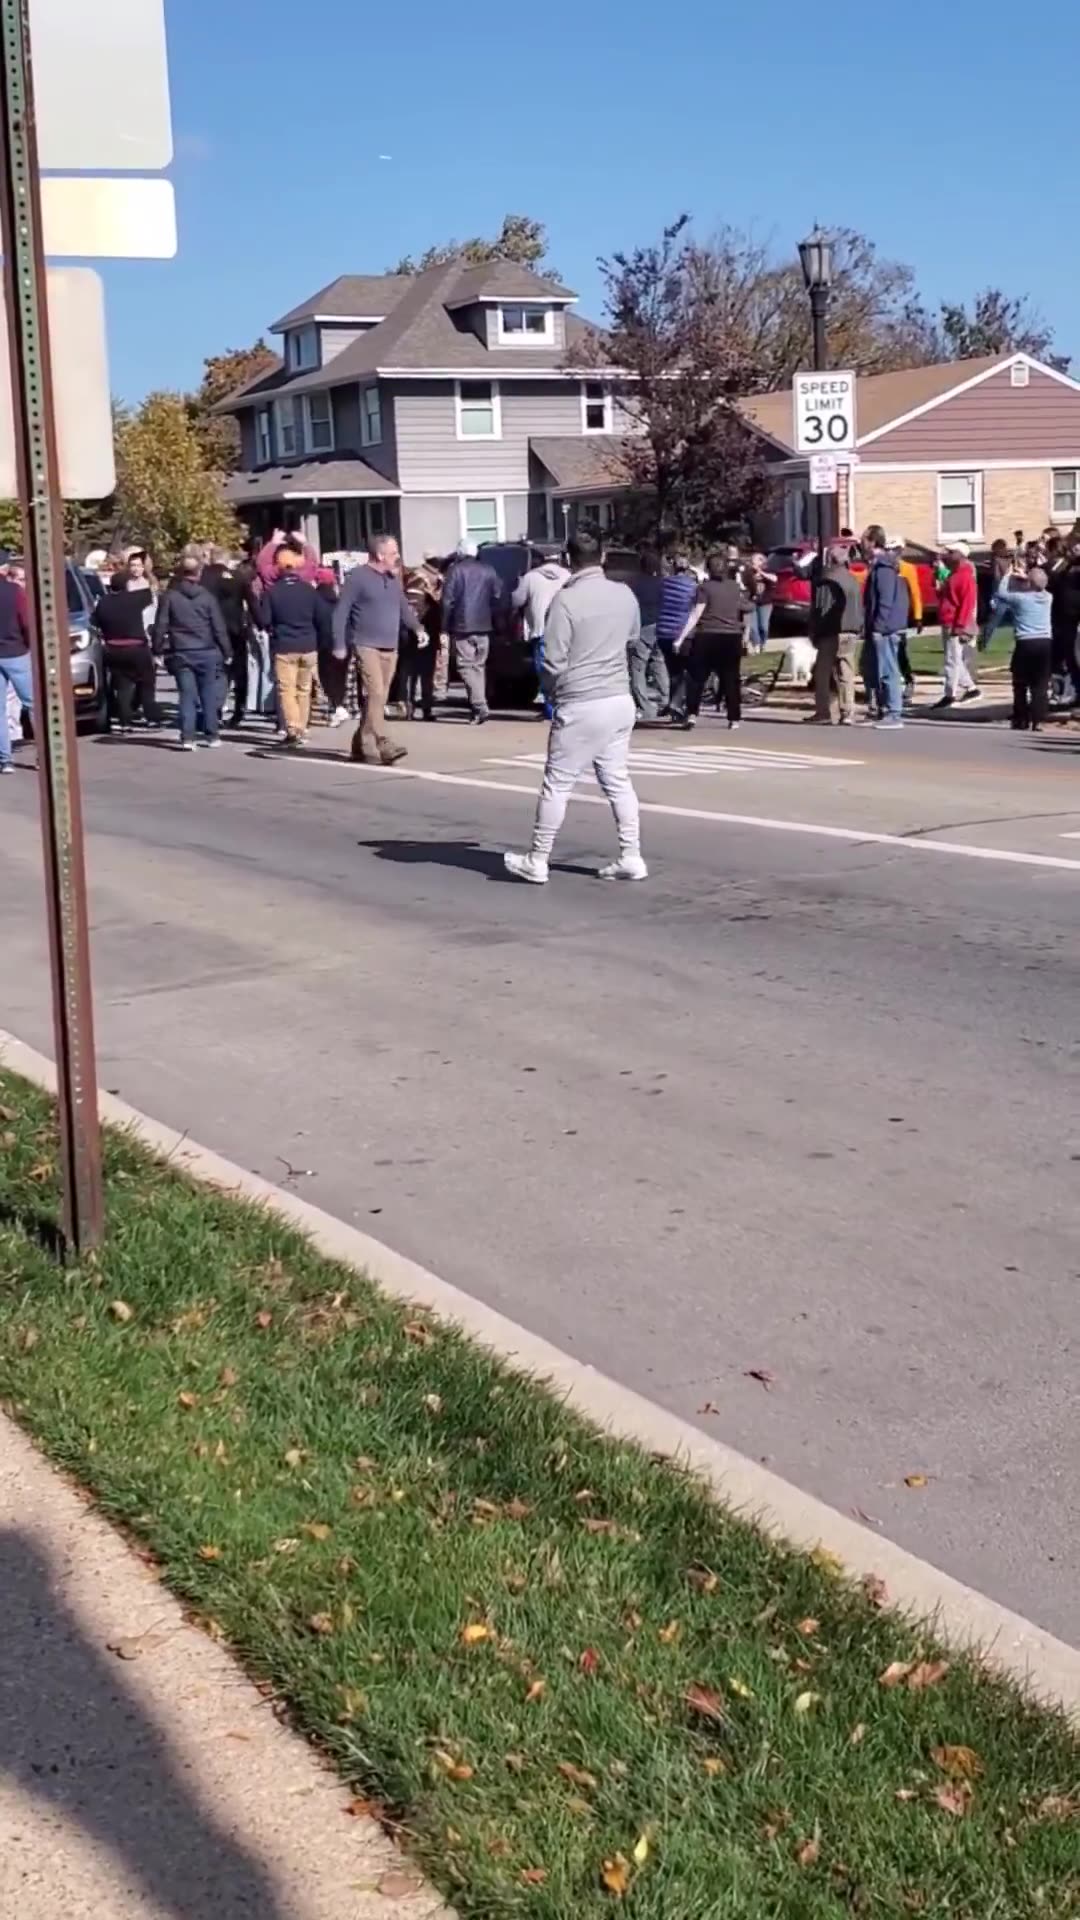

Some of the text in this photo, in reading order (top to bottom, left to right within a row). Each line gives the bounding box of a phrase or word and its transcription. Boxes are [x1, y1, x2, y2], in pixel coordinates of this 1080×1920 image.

[800, 381, 849, 395] SPEED
[805, 397, 844, 411] LIMIT
[804, 414, 848, 443] 30
